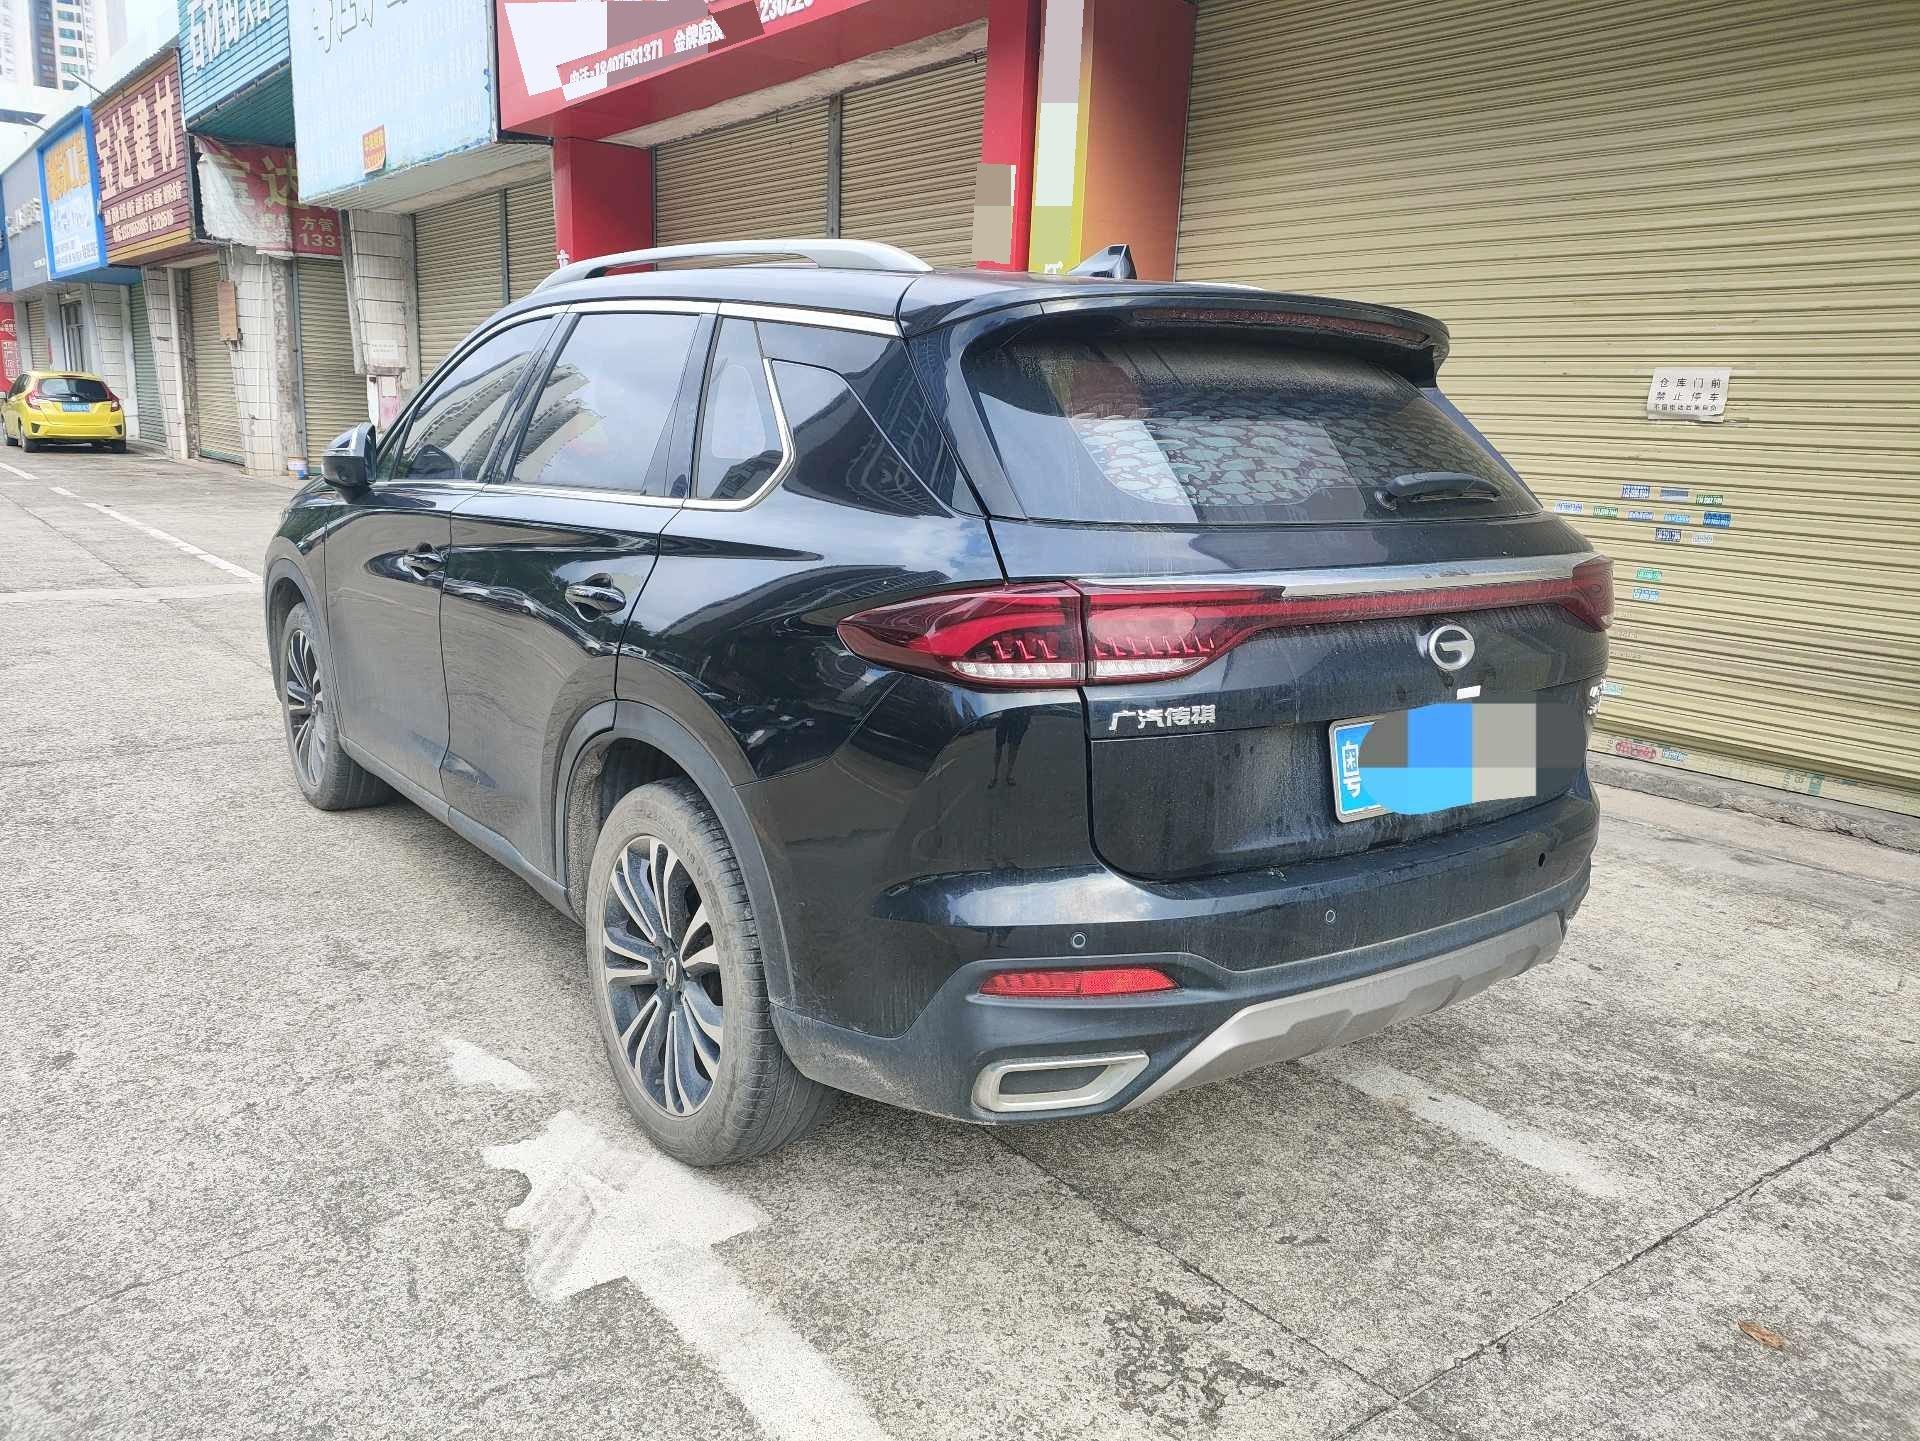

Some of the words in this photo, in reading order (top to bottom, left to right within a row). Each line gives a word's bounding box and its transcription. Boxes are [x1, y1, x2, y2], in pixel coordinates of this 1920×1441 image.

[1659, 377, 1721, 389] 仓库门前
[1655, 391, 1720, 402] 禁止停车
[1108, 704, 1216, 731] 广汽传祺
